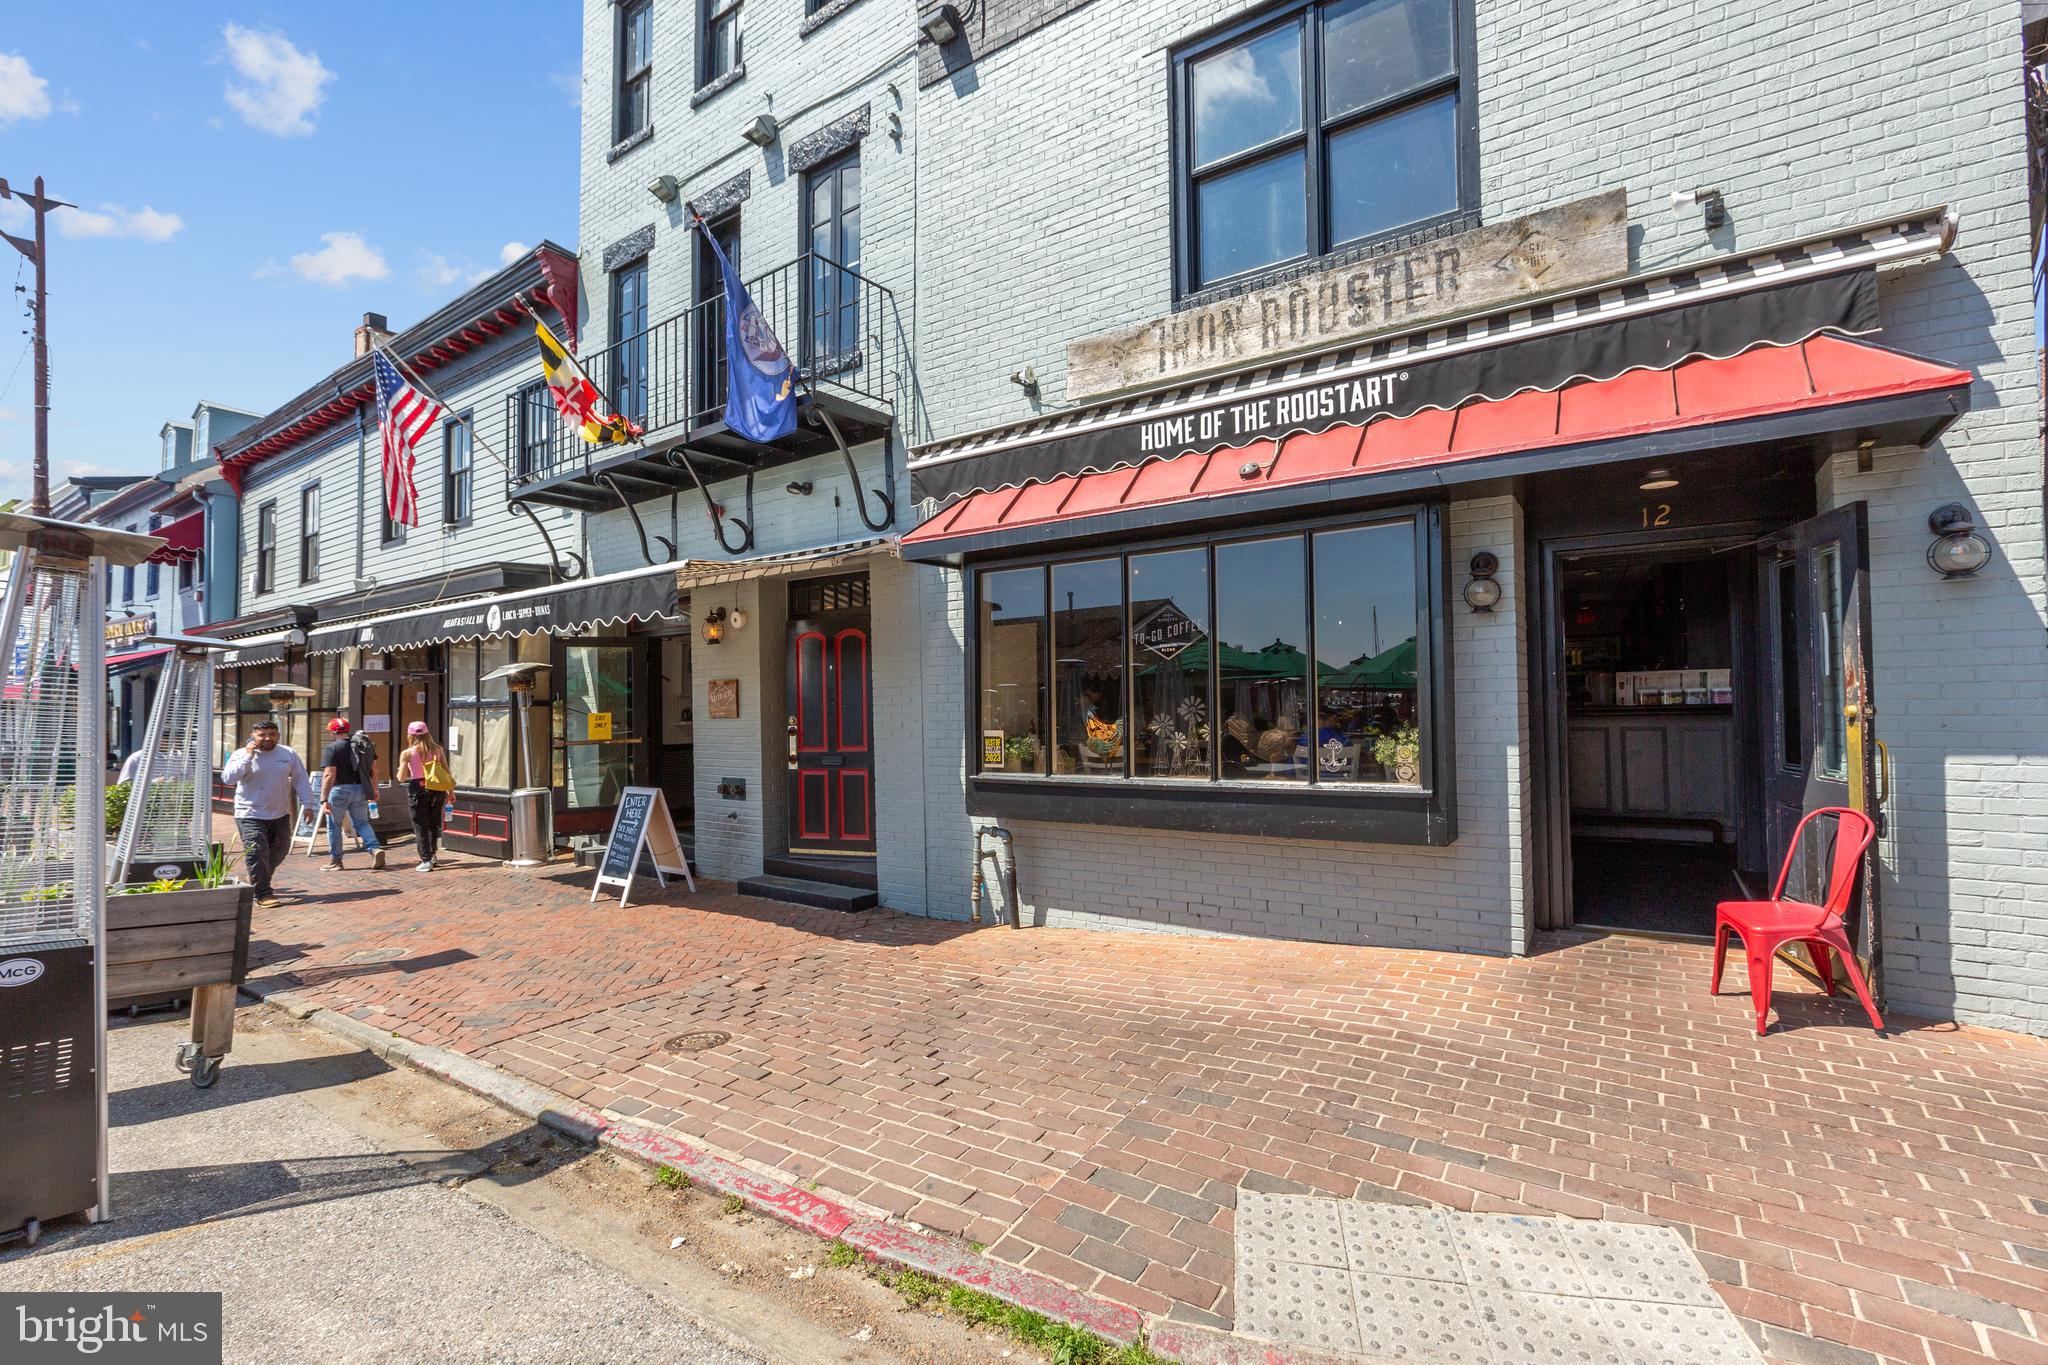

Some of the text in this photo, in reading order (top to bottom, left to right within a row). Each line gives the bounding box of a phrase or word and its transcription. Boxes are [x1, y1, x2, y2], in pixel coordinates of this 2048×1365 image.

[1260, 247, 1462, 350] ROOSTER
[1140, 415, 1196, 451] HOME
[1199, 408, 1226, 440] OF
[1230, 399, 1271, 435] THE
[1641, 504, 1671, 527] 12
[1134, 628, 1163, 645] TO-GO
[625, 796, 647, 808] ENTER
[626, 808, 642, 819] HERE
